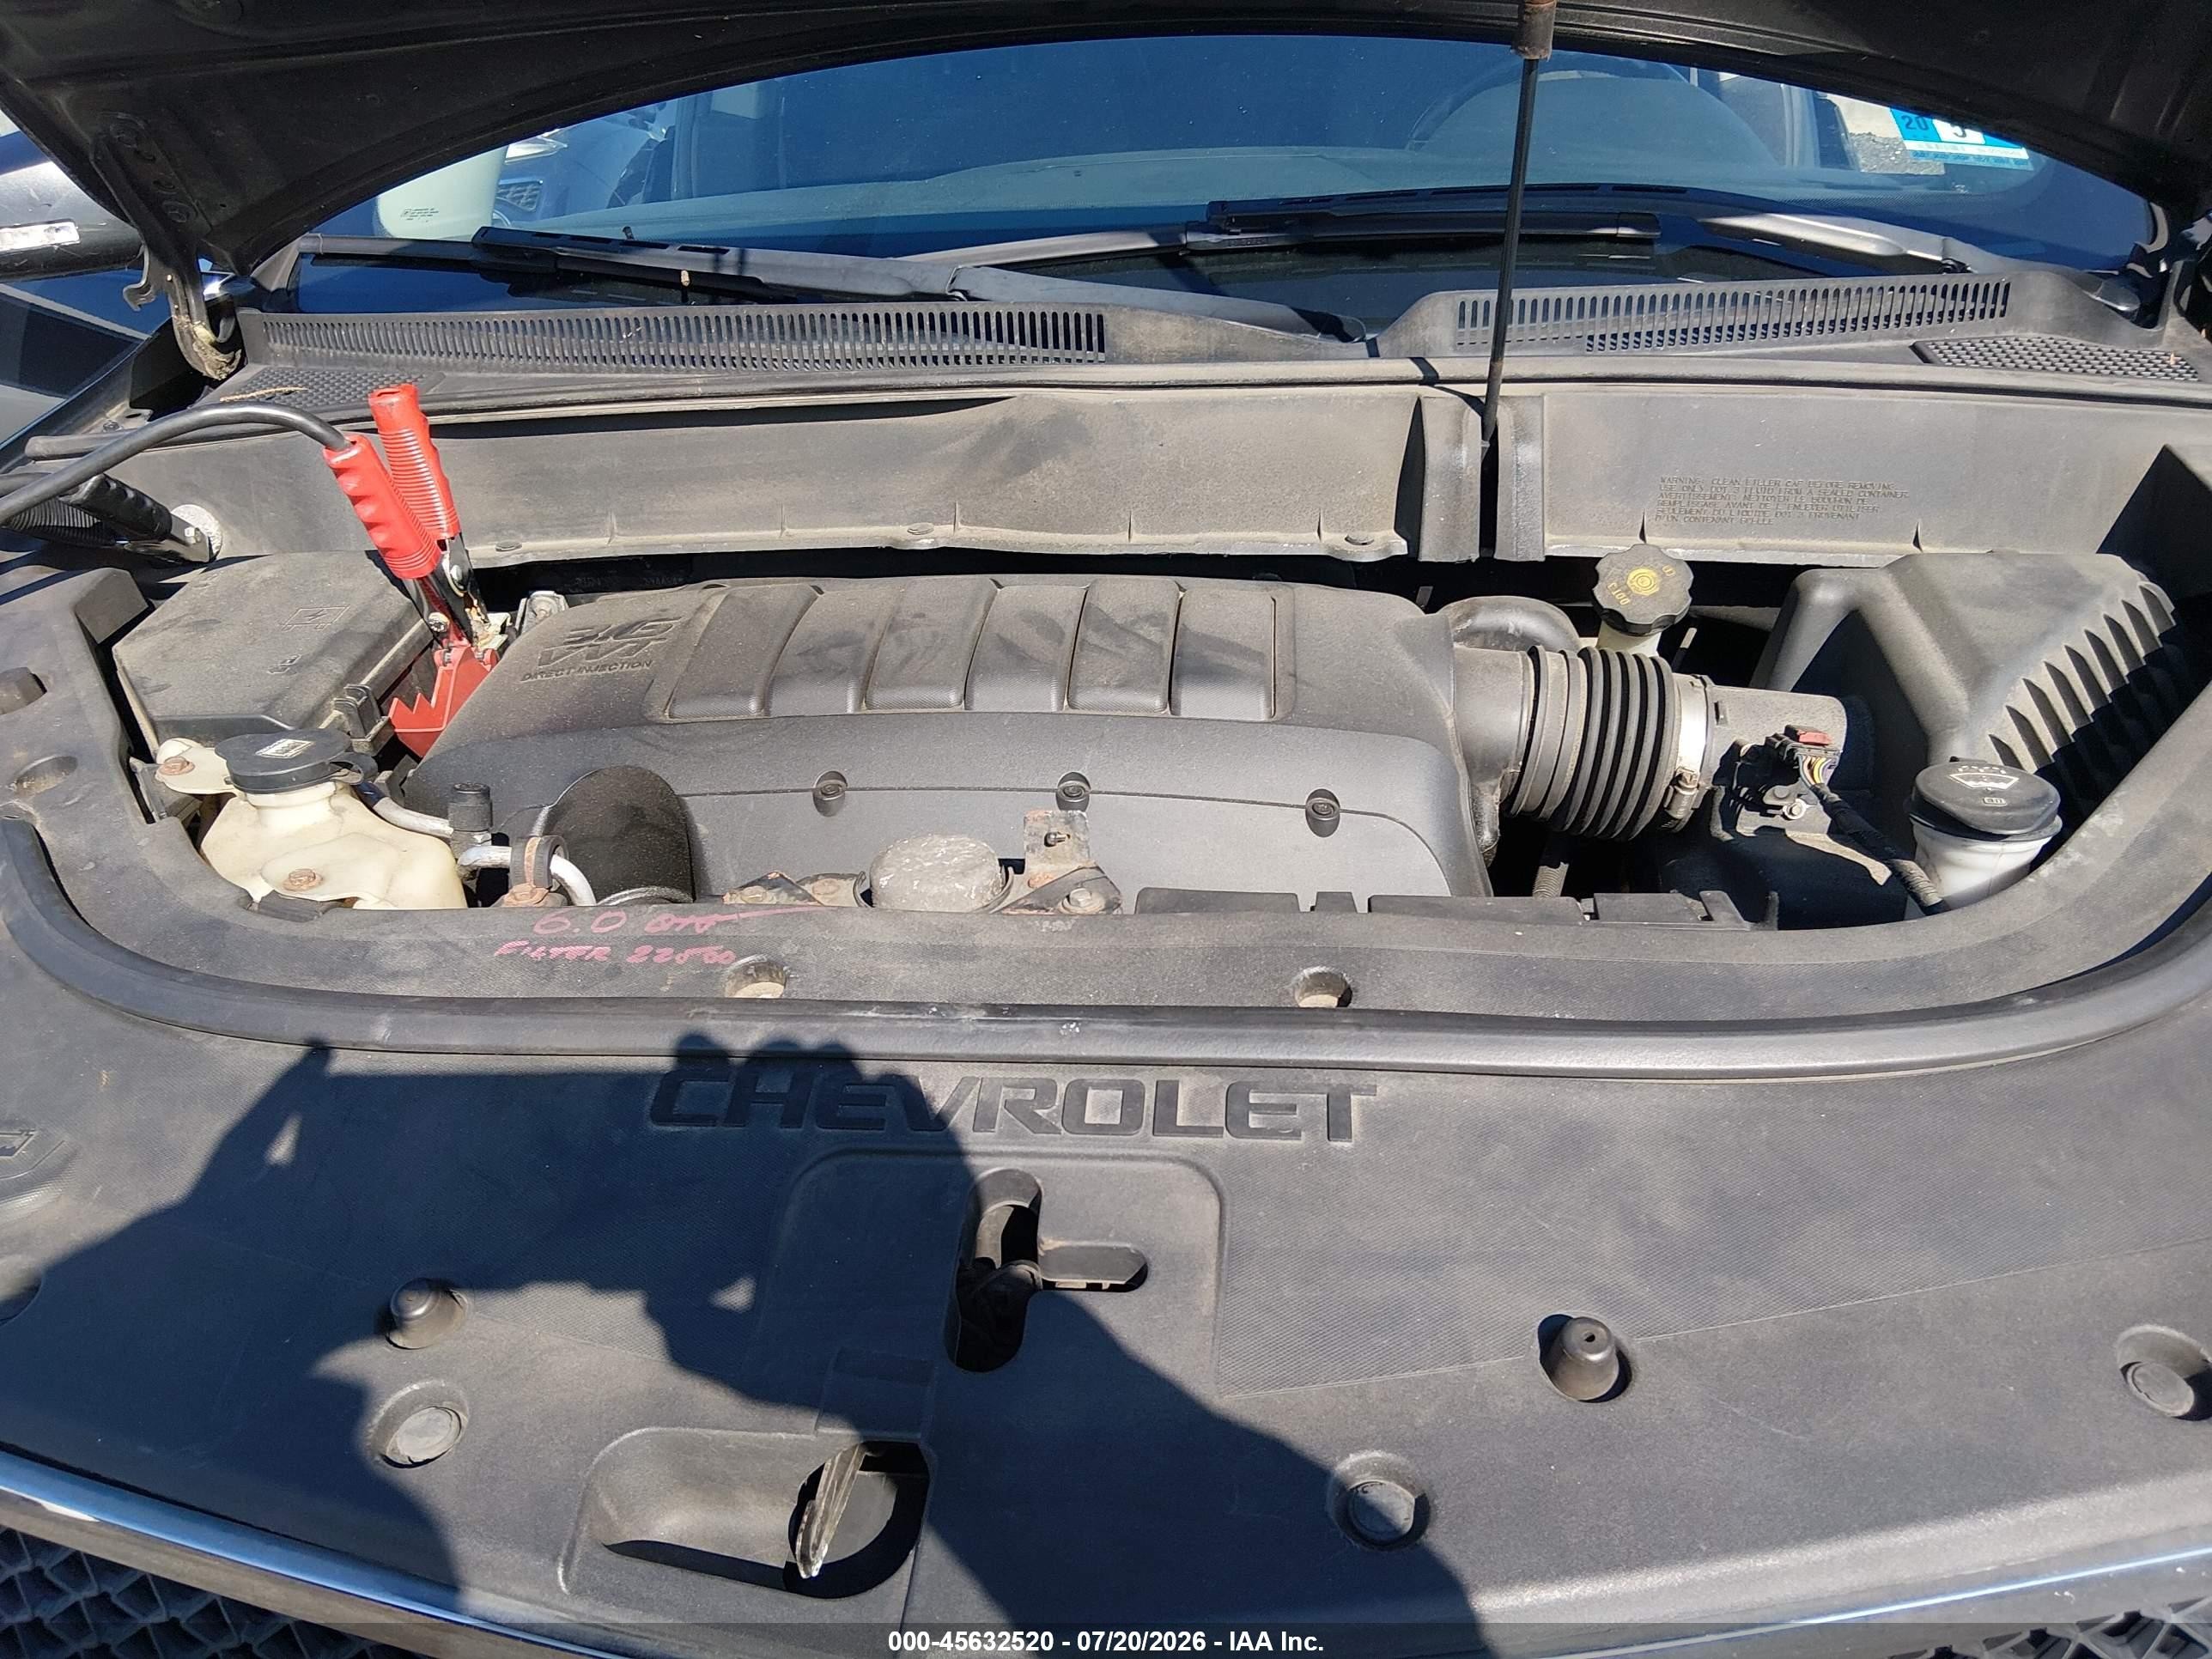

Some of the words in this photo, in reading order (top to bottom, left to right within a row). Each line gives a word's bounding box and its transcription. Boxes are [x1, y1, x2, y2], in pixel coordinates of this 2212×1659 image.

[1901, 115, 1929, 131] 20
[1711, 477, 1741, 486] CLEAN
[1745, 478, 1781, 487] FILLER
[1808, 480, 1844, 489] BEFORE
[1681, 484, 1705, 493] ONLY
[1778, 487, 1802, 495] FROM
[1818, 489, 1854, 497] SEALED
[1656, 500, 1718, 508] REMPLISSAGE
[1742, 494, 1790, 503] NETTOYER
[1811, 496, 1852, 505] BOUCHON
[1656, 507, 1710, 516] SEULEMENT
[1729, 509, 1771, 518] LIQUIDE
[1808, 512, 1861, 520] PROVENANT
[1683, 515, 1735, 524] CONTENANT
[521, 666, 574, 682] DIRECT
[576, 659, 654, 675] INJECTION
[533, 908, 628, 935] 6.0
[650, 1069, 1377, 1142] CHEVROLET
